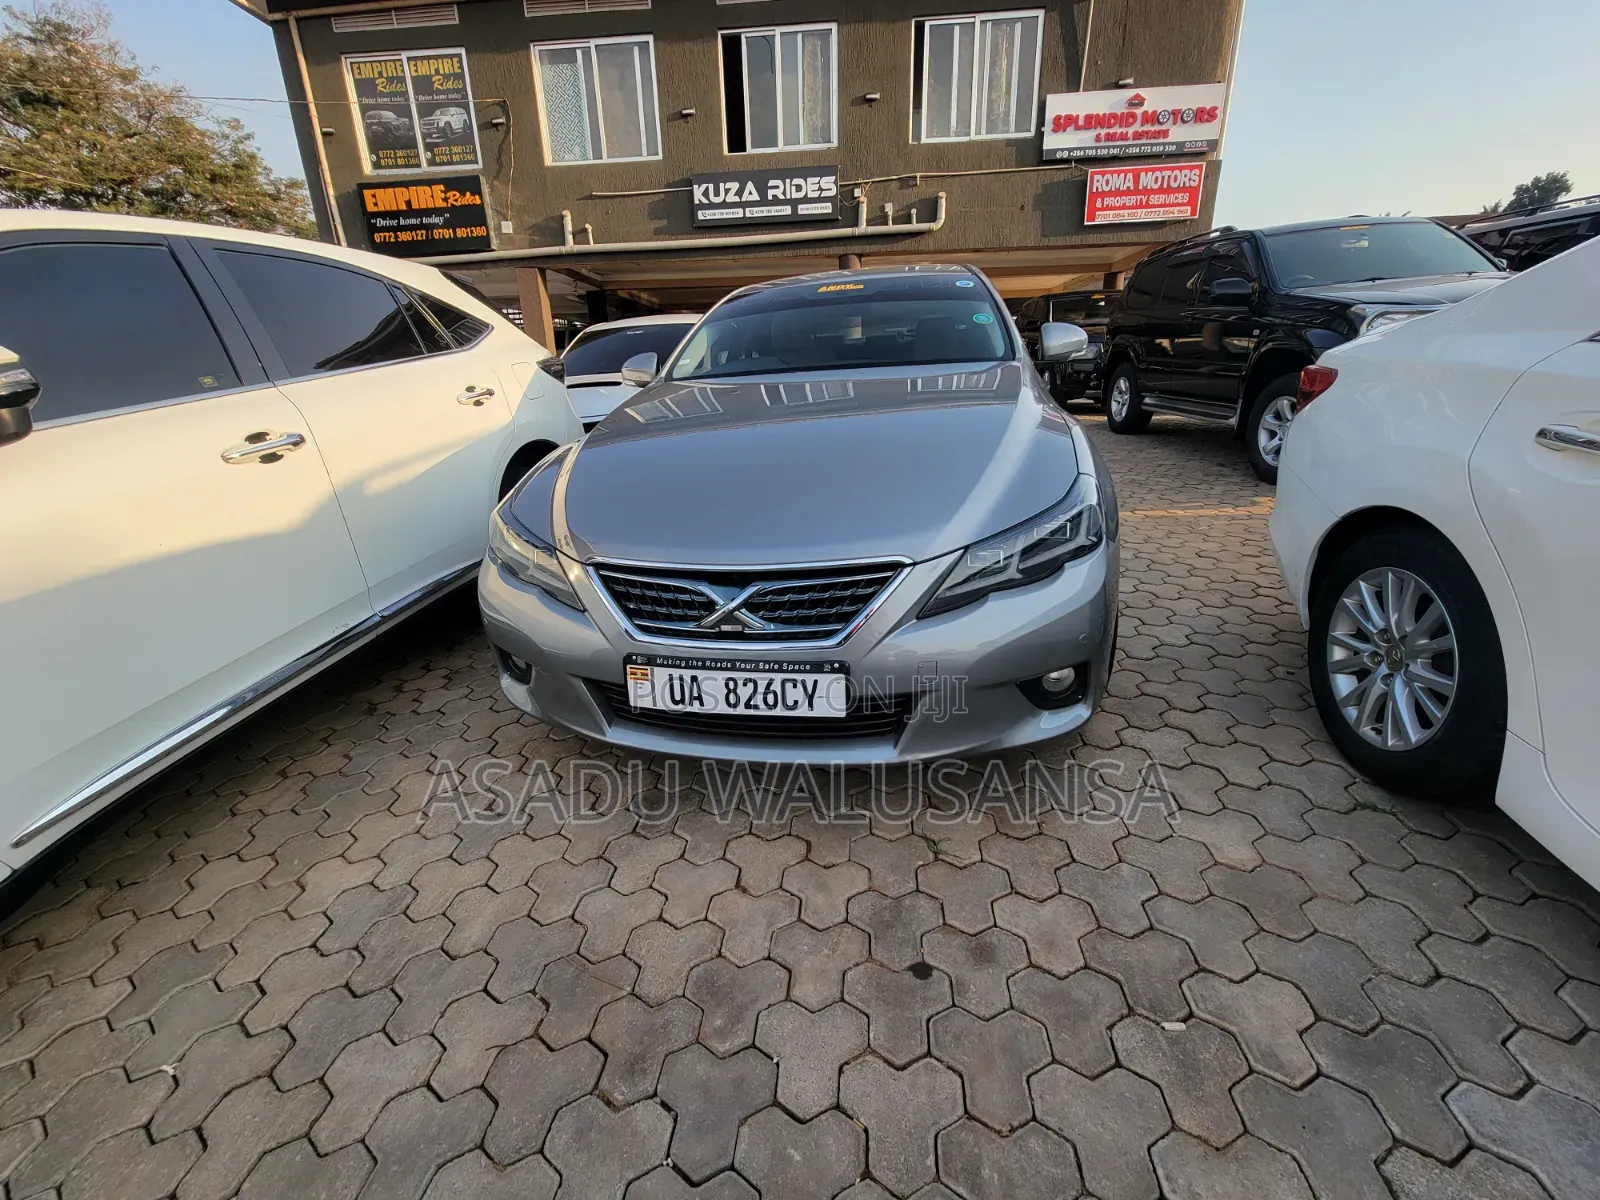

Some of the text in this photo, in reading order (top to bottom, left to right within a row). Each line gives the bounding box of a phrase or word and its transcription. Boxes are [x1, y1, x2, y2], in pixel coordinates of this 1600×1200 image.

[352, 62, 404, 79] EMPIRE
[409, 57, 461, 77] EMPIRE
[376, 78, 406, 93] Rides
[432, 75, 463, 90] Rides
[1051, 106, 1219, 133] SPLENDID MOTORS
[1095, 128, 1170, 143] & REAL ESTATE
[379, 149, 417, 158] 0772 360127
[434, 145, 473, 155] 0772 360127
[380, 158, 396, 166] 0701
[435, 153, 475, 163] 0701 801360
[1092, 169, 1199, 193] ROMA MOTORS
[693, 176, 837, 204] KUZA RIDES
[363, 184, 482, 212] EMPIRE Rides
[1096, 193, 1189, 208] & PROPERTY SERVICES
[400, 217, 421, 226] home
[374, 231, 396, 243] 0772
[397, 230, 426, 242] 360127
[433, 227, 454, 239] 0701
[456, 226, 487, 238] 801360
[657, 658, 686, 667] Making
[705, 660, 732, 668] Roads
[735, 661, 755, 669] Your
[759, 662, 779, 670] Safe
[782, 663, 811, 671] Space
[668, 673, 818, 711] UA 826CY
